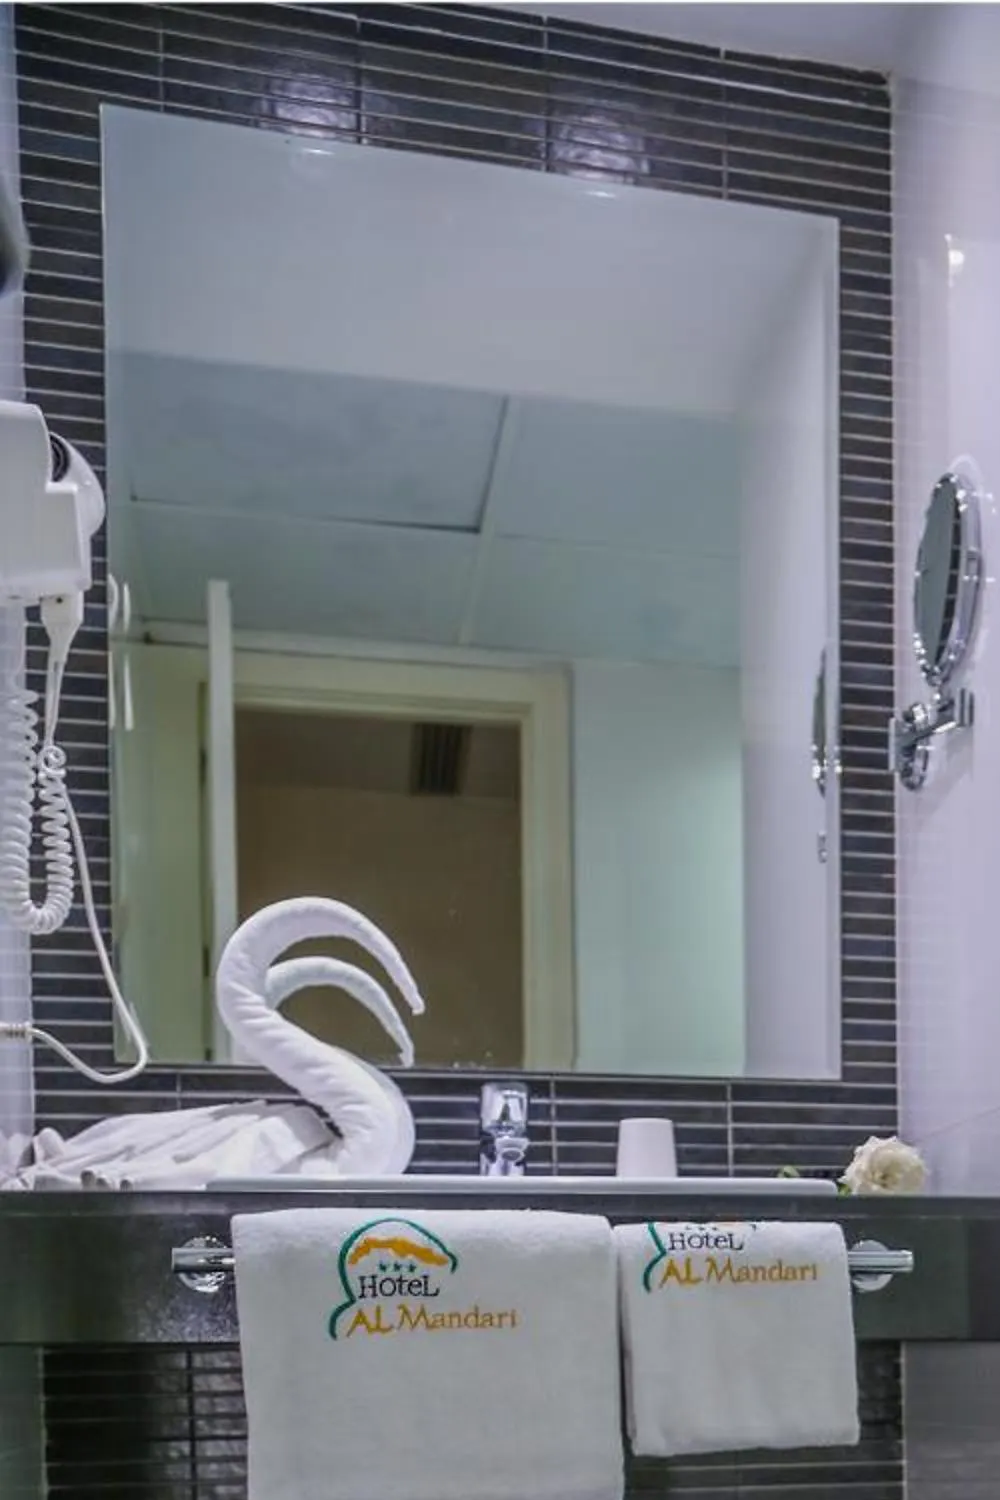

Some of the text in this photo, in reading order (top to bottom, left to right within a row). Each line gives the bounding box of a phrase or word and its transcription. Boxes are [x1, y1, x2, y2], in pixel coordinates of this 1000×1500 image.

[659, 1255, 818, 1288] AL Mandari
[346, 1303, 517, 1337] AL Mandari
